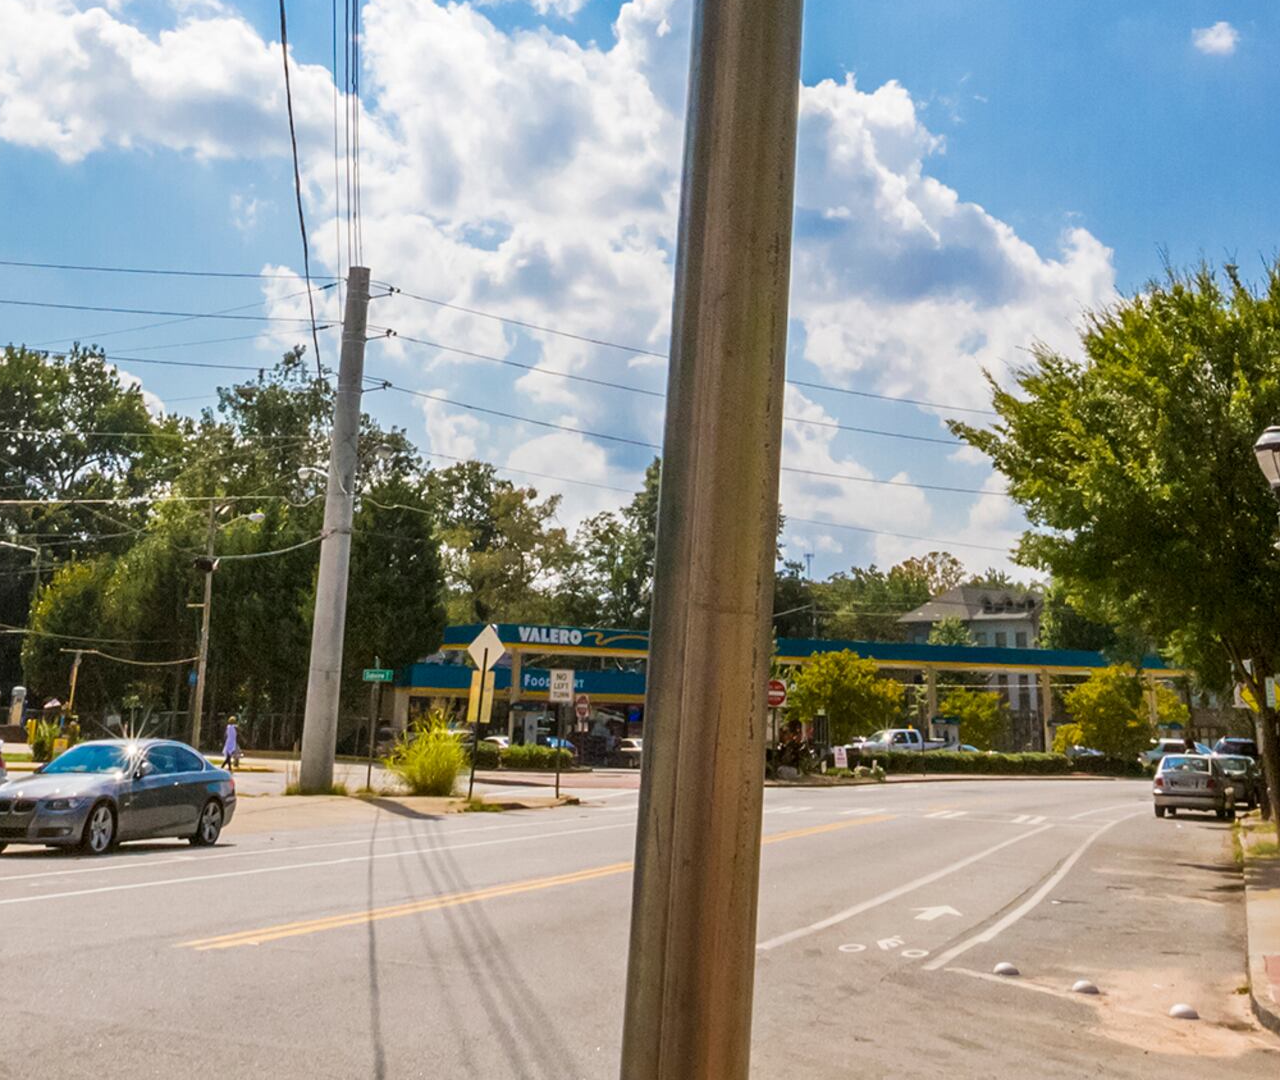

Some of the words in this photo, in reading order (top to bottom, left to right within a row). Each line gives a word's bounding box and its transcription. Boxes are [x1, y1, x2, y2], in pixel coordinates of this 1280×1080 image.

[518, 626, 582, 644] VALERO
[556, 672, 568, 681] NO
[553, 682, 569, 690] LEFT
[552, 691, 570, 699] TURN
